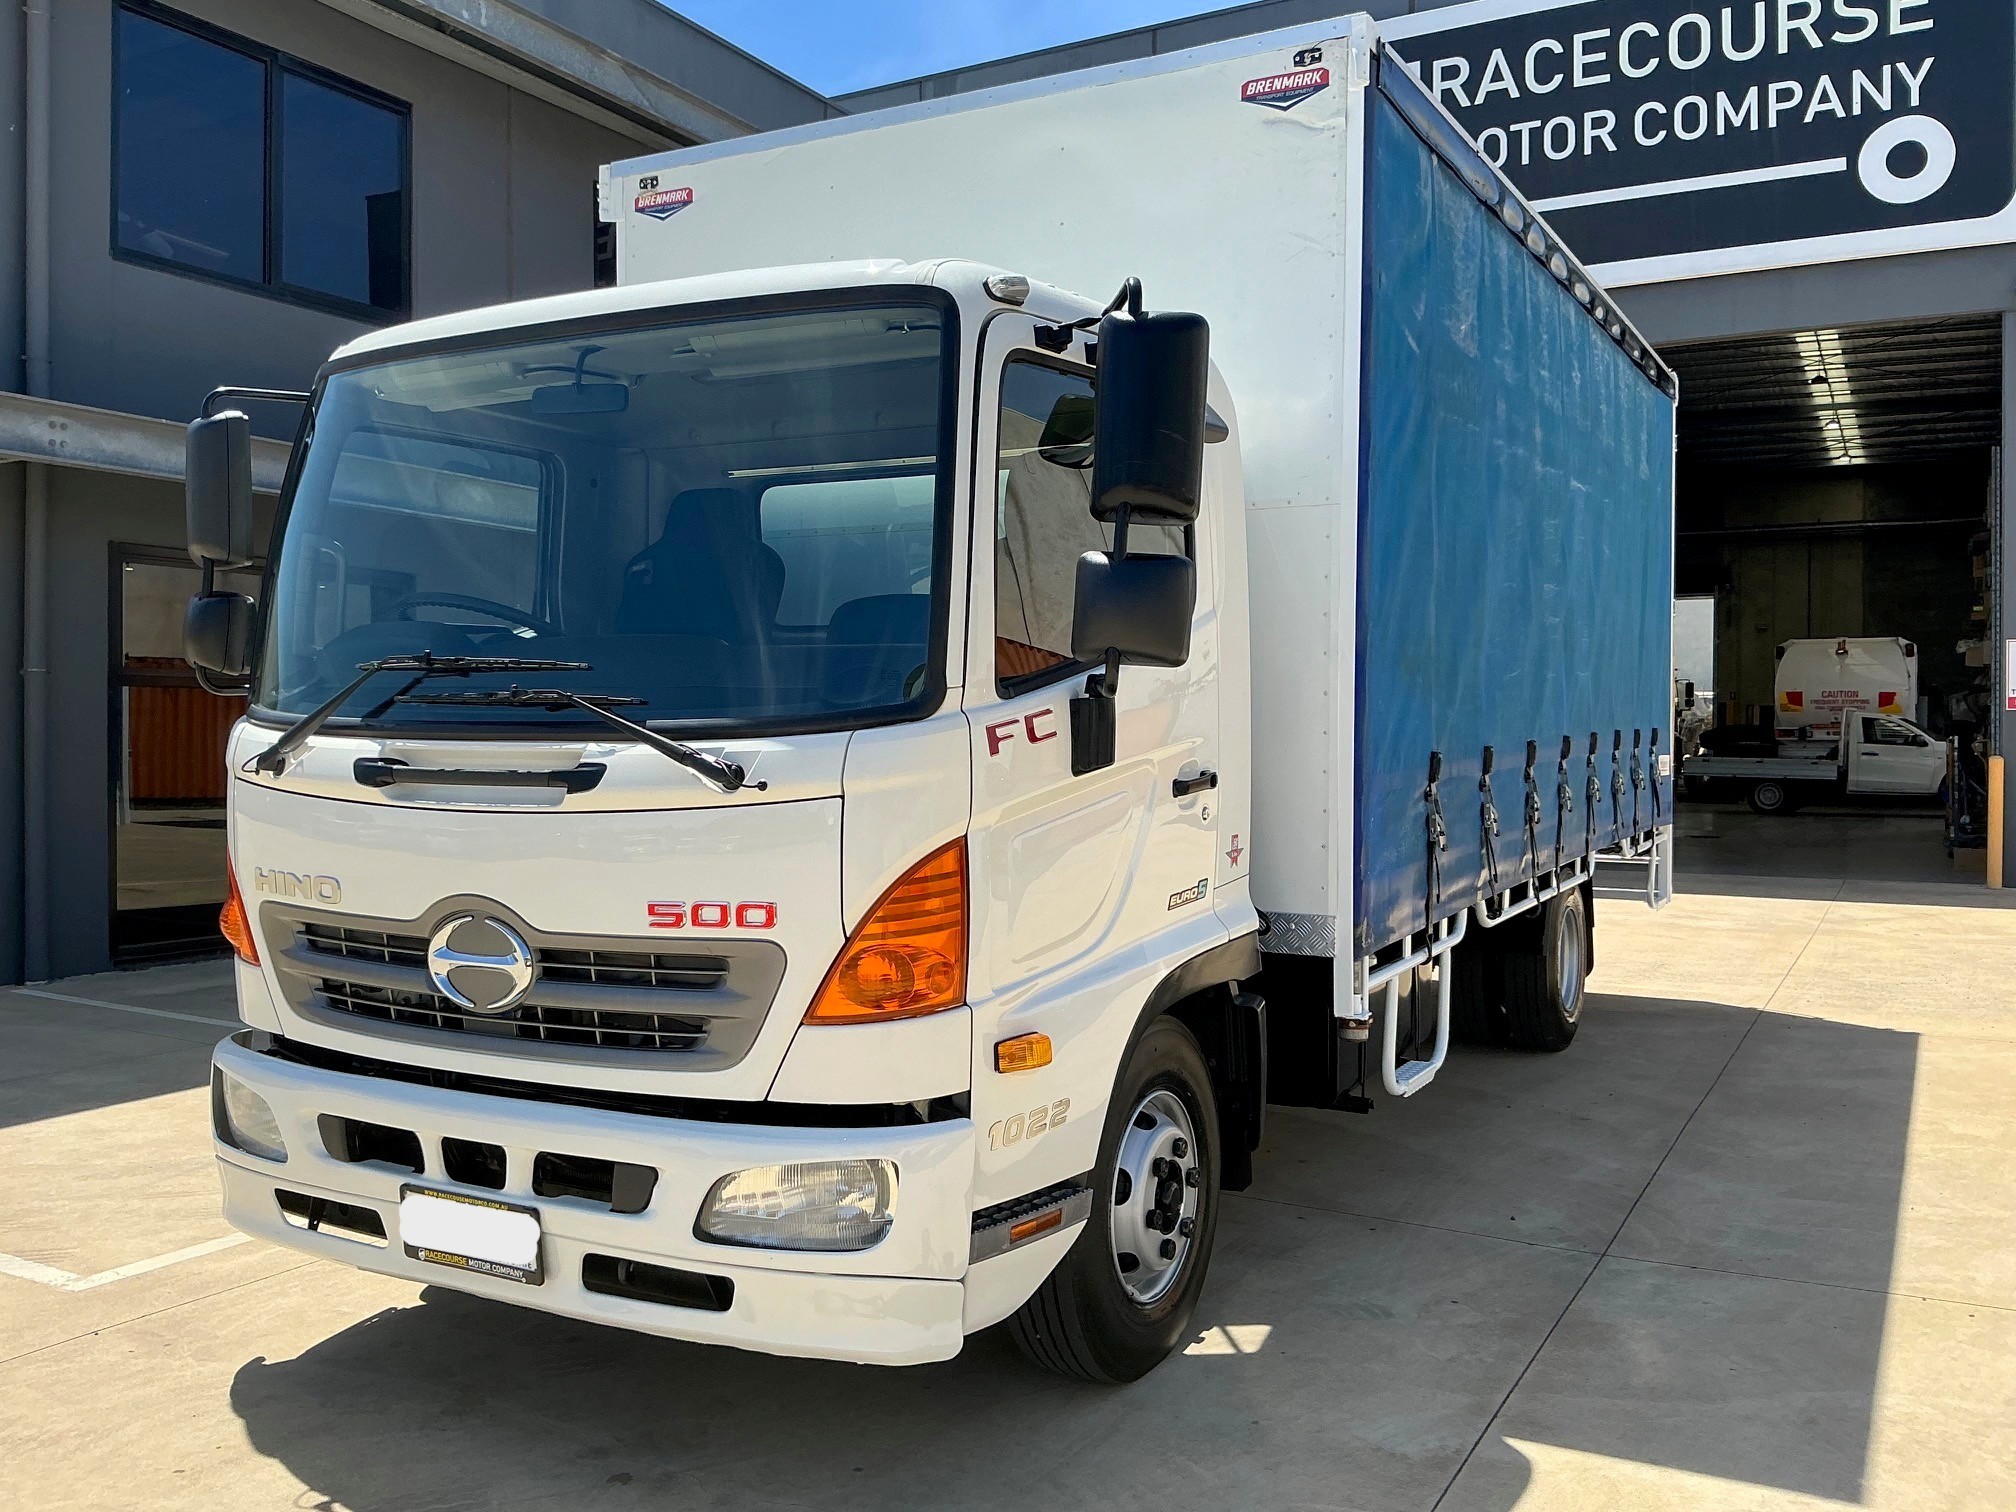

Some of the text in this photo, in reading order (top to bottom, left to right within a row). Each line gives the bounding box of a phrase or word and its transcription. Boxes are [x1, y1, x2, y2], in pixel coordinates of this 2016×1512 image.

[1432, 0, 1934, 108] RACECOURSE
[1246, 69, 1325, 96] BRENMARK
[1286, 86, 1315, 97] EQUIPMENT
[1476, 56, 1935, 169] OTOR COMPANY
[638, 189, 690, 208] BRENMARK
[1821, 690, 1859, 699] CAUTION
[985, 707, 1058, 757] FC
[254, 866, 342, 905] HINO
[647, 900, 779, 930] 500
[987, 1097, 1071, 1152] 1022
[425, 1249, 468, 1267] RACECOURSE
[468, 1258, 492, 1272] MOTOR
[492, 1264, 524, 1279] COMPANY
